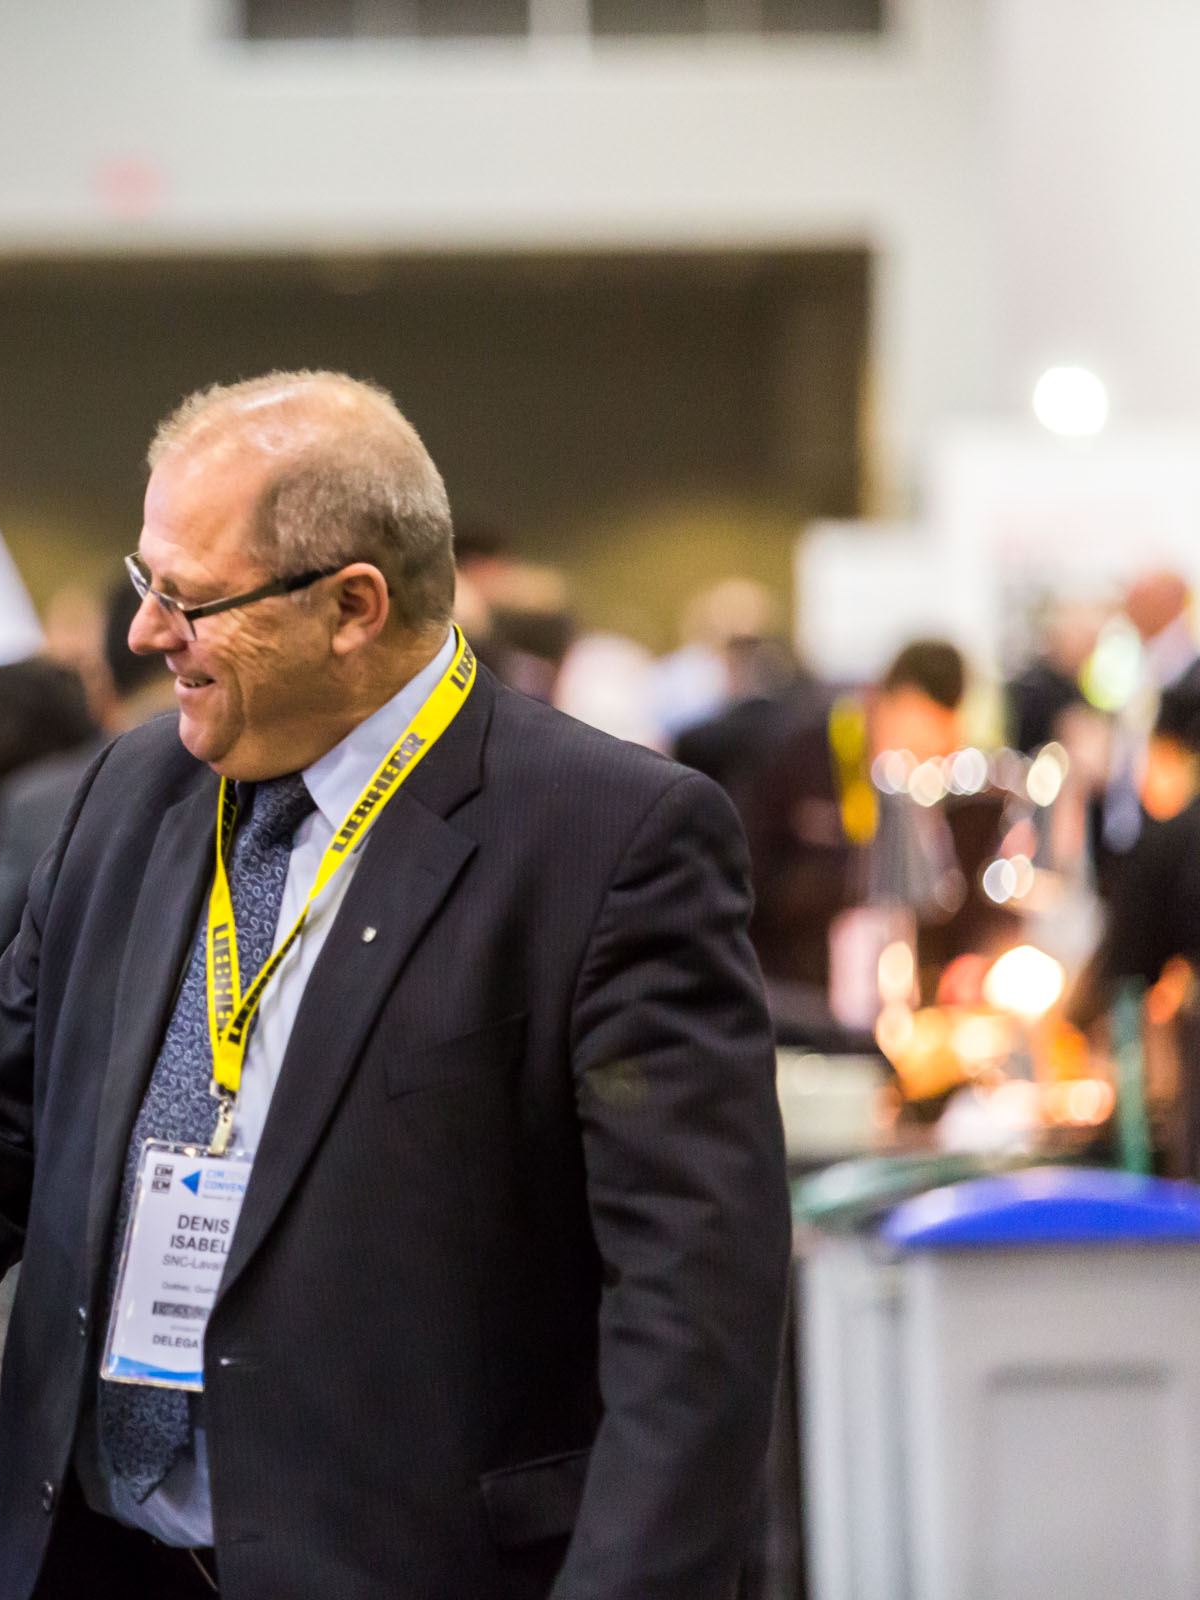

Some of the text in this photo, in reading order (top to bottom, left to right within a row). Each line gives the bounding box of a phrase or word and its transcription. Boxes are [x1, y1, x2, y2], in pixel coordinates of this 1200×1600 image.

[331, 732, 426, 852] LIEBHERR
[177, 1214, 230, 1234] DENIS
[152, 1334, 199, 1348] DELEGA
